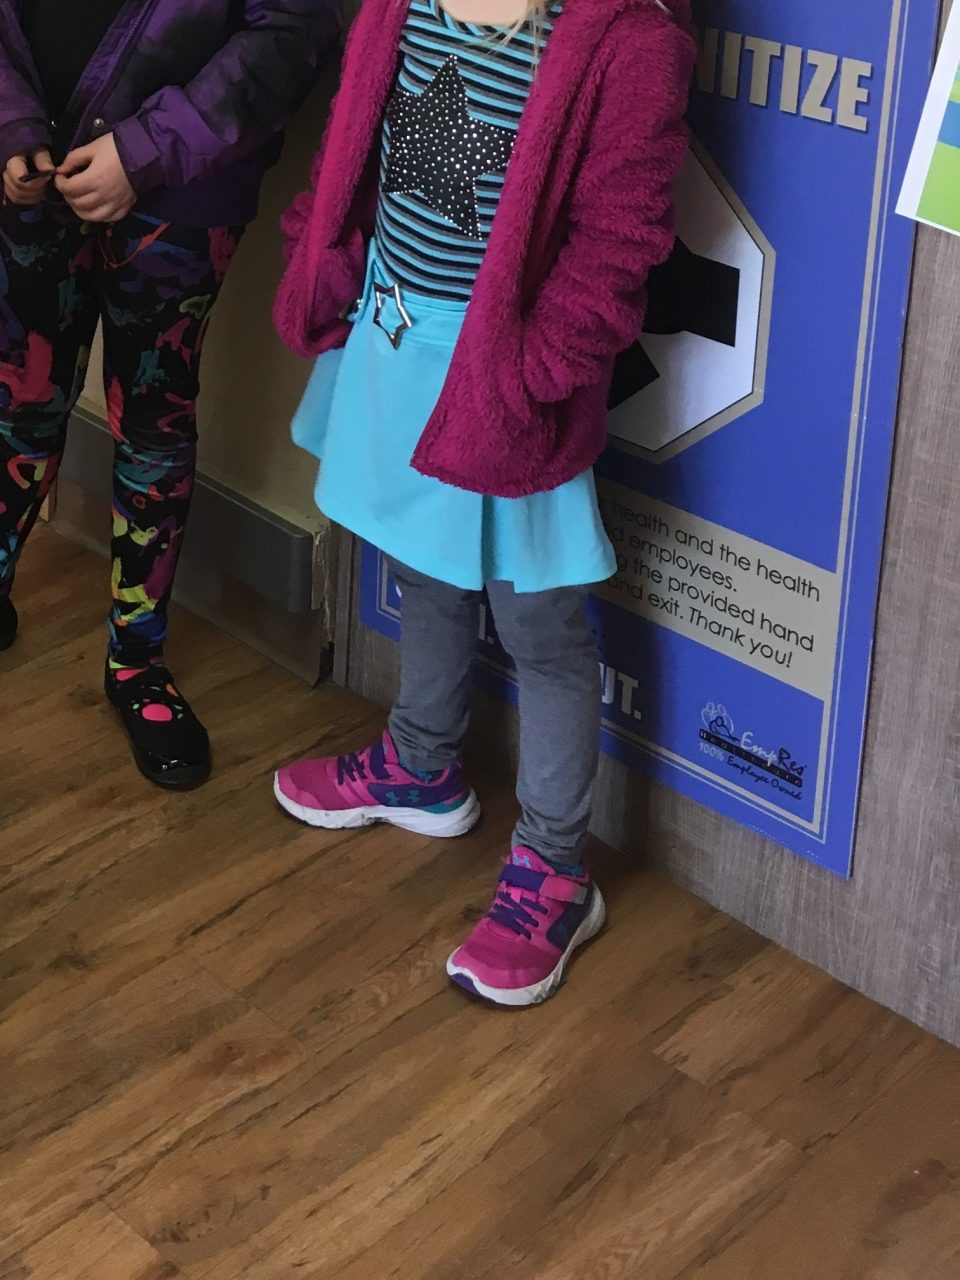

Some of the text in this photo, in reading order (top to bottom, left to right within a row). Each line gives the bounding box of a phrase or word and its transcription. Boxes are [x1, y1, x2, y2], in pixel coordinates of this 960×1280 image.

[613, 500, 669, 537] health
[675, 529, 713, 556] and
[720, 543, 750, 571] the
[757, 558, 820, 602] health
[629, 535, 737, 592] employees.
[634, 557, 662, 584] the
[668, 576, 755, 625] provided
[760, 612, 814, 652] hand
[648, 593, 683, 619] exit.
[689, 606, 746, 647] Thank
[749, 638, 792, 668] you!
[699, 742, 802, 800] 100% Employee Owned
